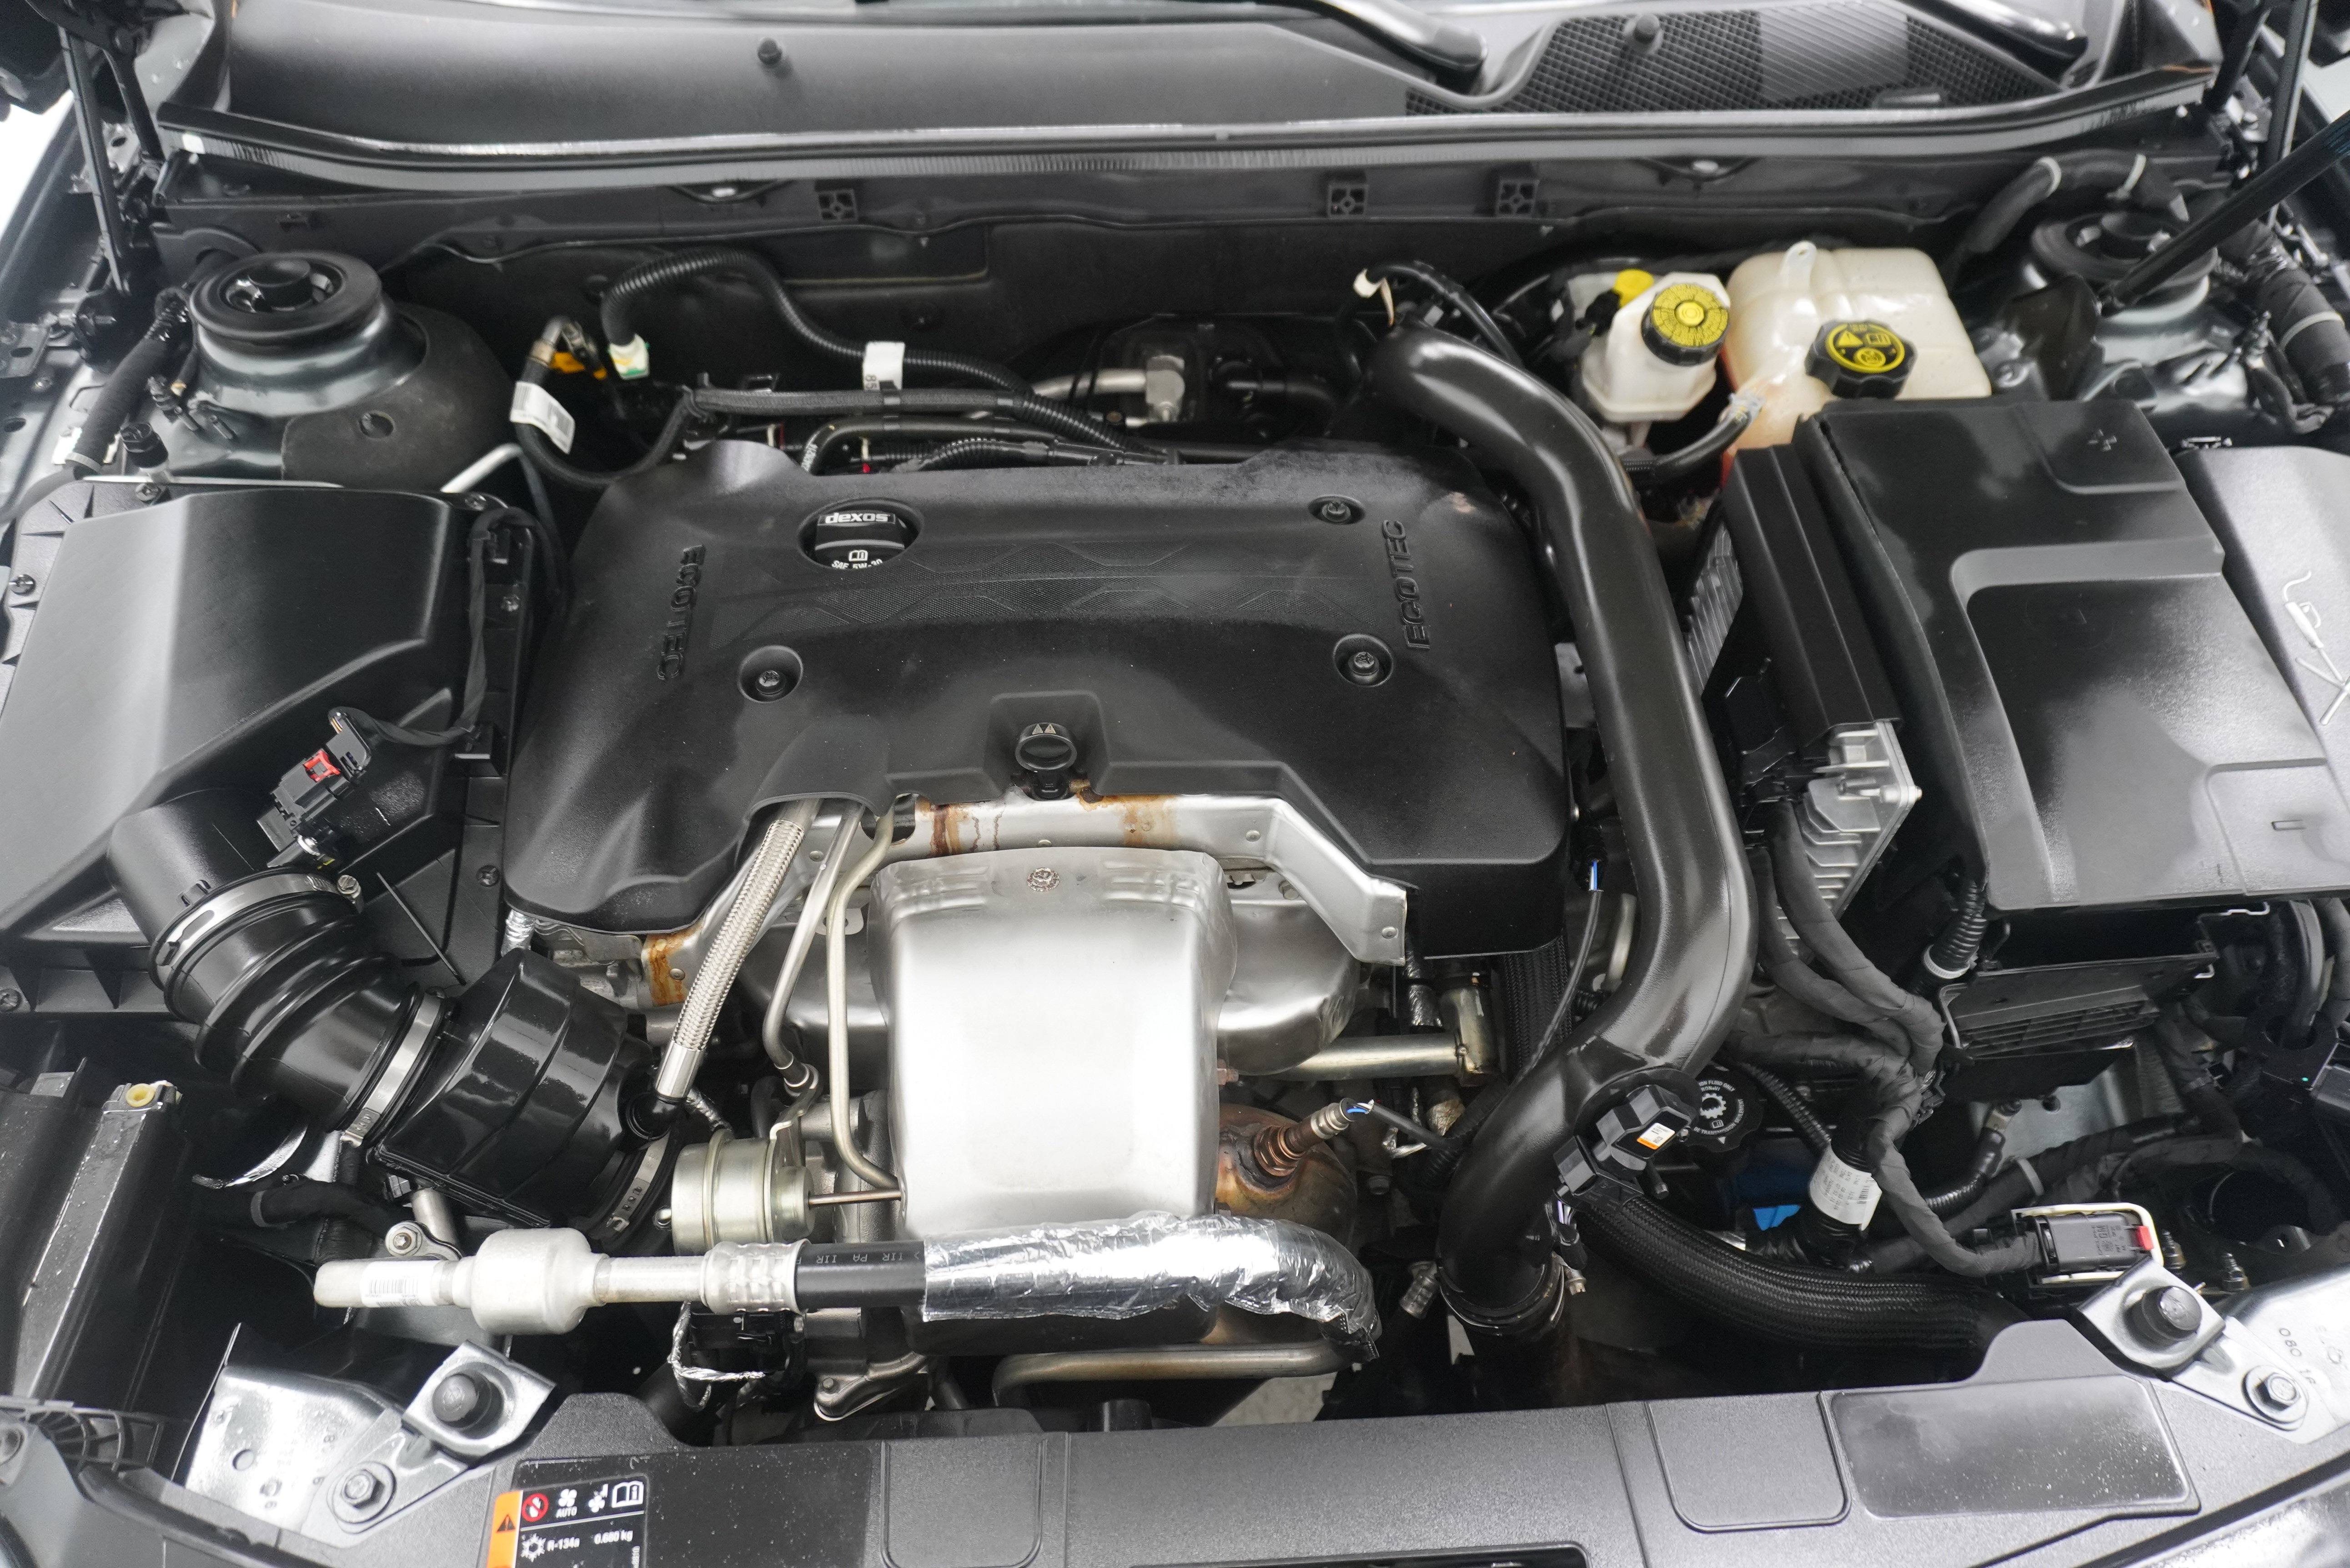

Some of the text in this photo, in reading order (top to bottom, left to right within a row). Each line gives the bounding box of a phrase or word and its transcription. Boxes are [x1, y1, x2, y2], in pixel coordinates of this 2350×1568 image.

[825, 513, 889, 523] dexos
[832, 560, 849, 569] SAE
[1382, 520, 1430, 648] ECOTEC
[656, 545, 704, 680] ECOTEC
[1723, 1083, 1736, 1091] ONLY
[556, 1506, 577, 1518] AUTO
[547, 1537, 580, 1552] R-134a
